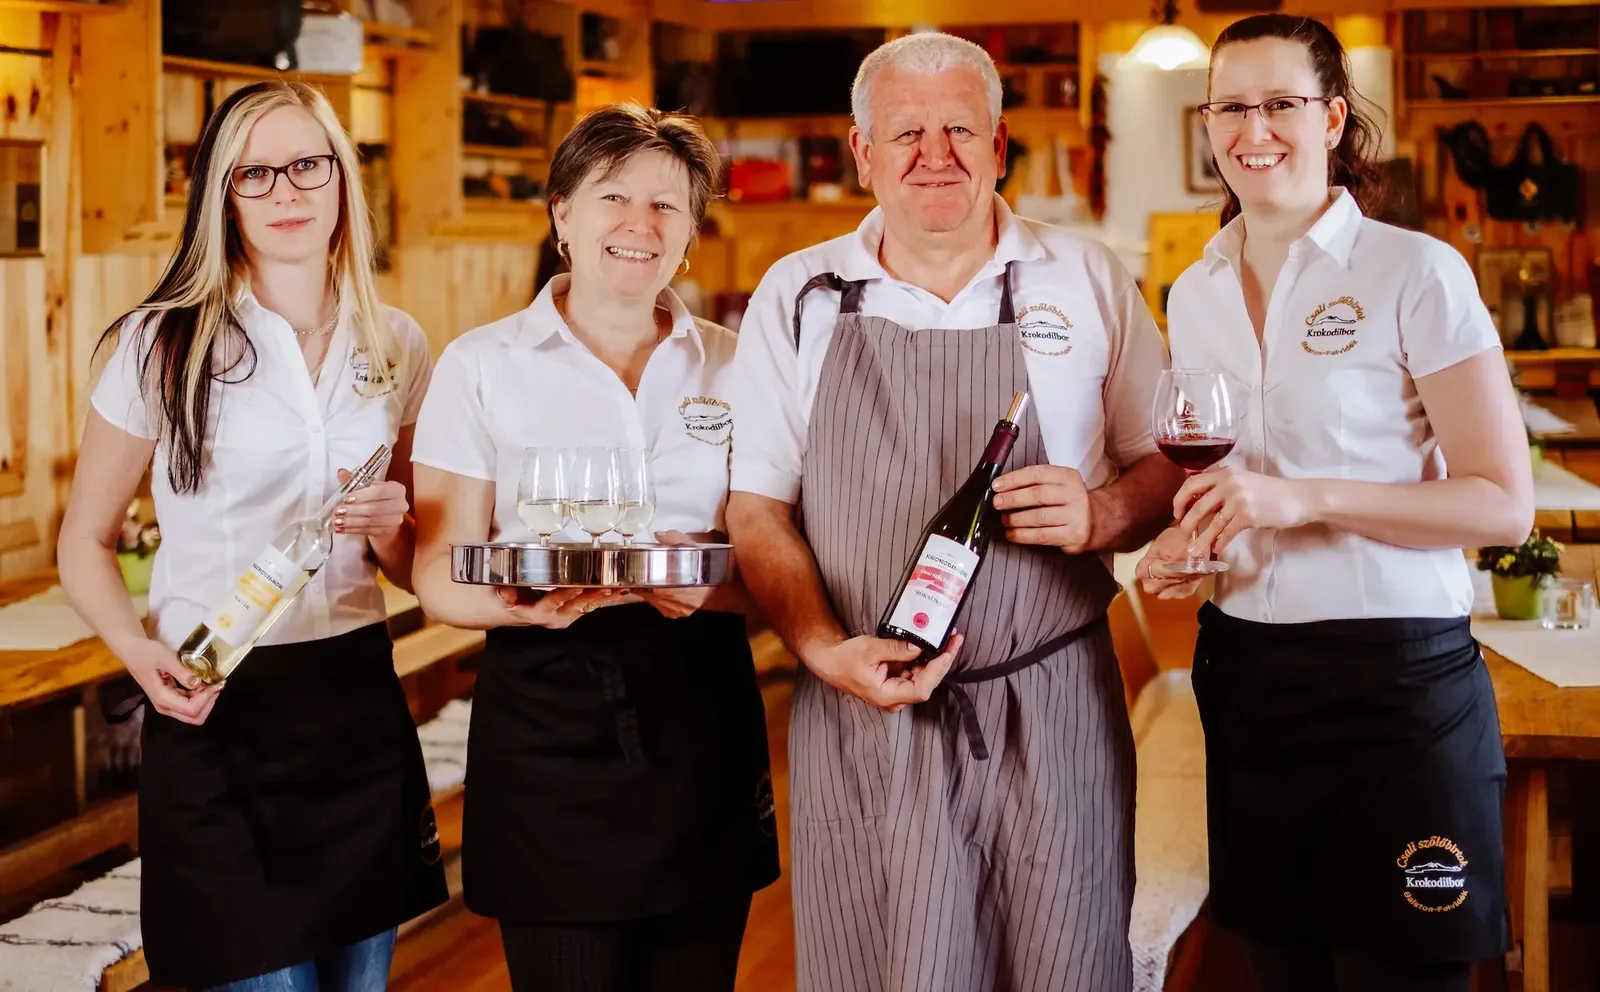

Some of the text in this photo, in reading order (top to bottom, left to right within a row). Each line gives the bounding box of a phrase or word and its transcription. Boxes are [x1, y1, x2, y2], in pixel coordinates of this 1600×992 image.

[1305, 303, 1326, 326] Csali
[1020, 330, 1070, 342] Krokodilbor
[1306, 328, 1357, 338] Krokodilbor
[685, 418, 733, 431] Krokodilbor
[1396, 835, 1468, 869] Csali szőlőbirtok
[1405, 876, 1465, 888] Krokodilbor
